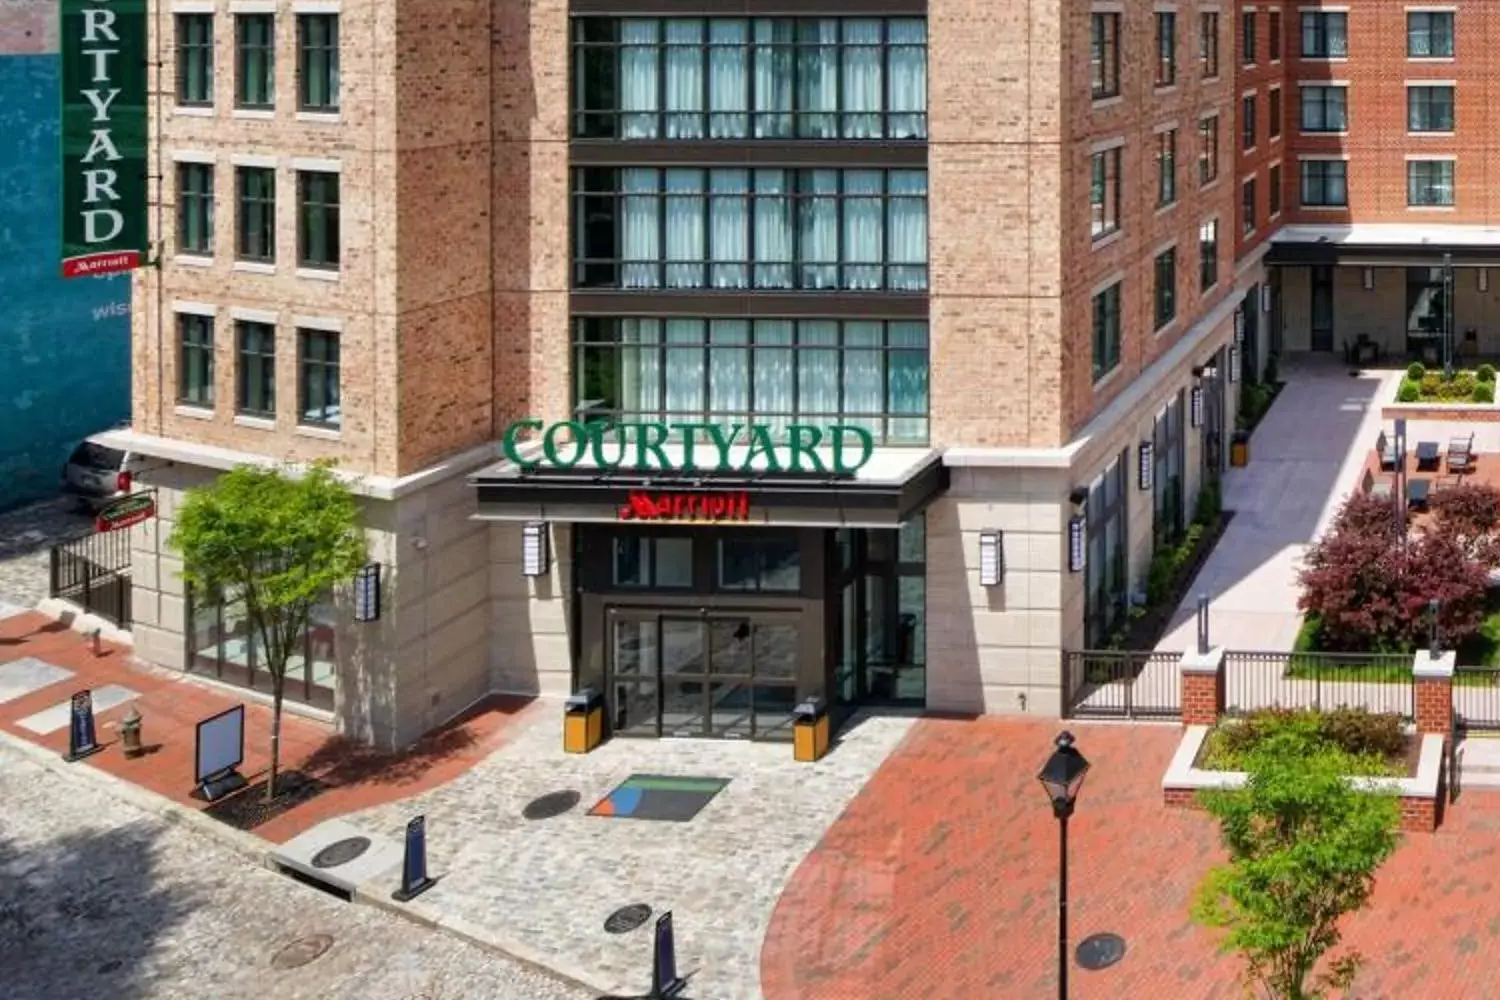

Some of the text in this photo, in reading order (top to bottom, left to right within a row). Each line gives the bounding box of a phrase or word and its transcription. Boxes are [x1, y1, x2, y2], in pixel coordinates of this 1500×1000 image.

[72, 256, 129, 274] Marriott
[505, 419, 874, 473] COURTYARD
[619, 490, 747, 521] Marriott
